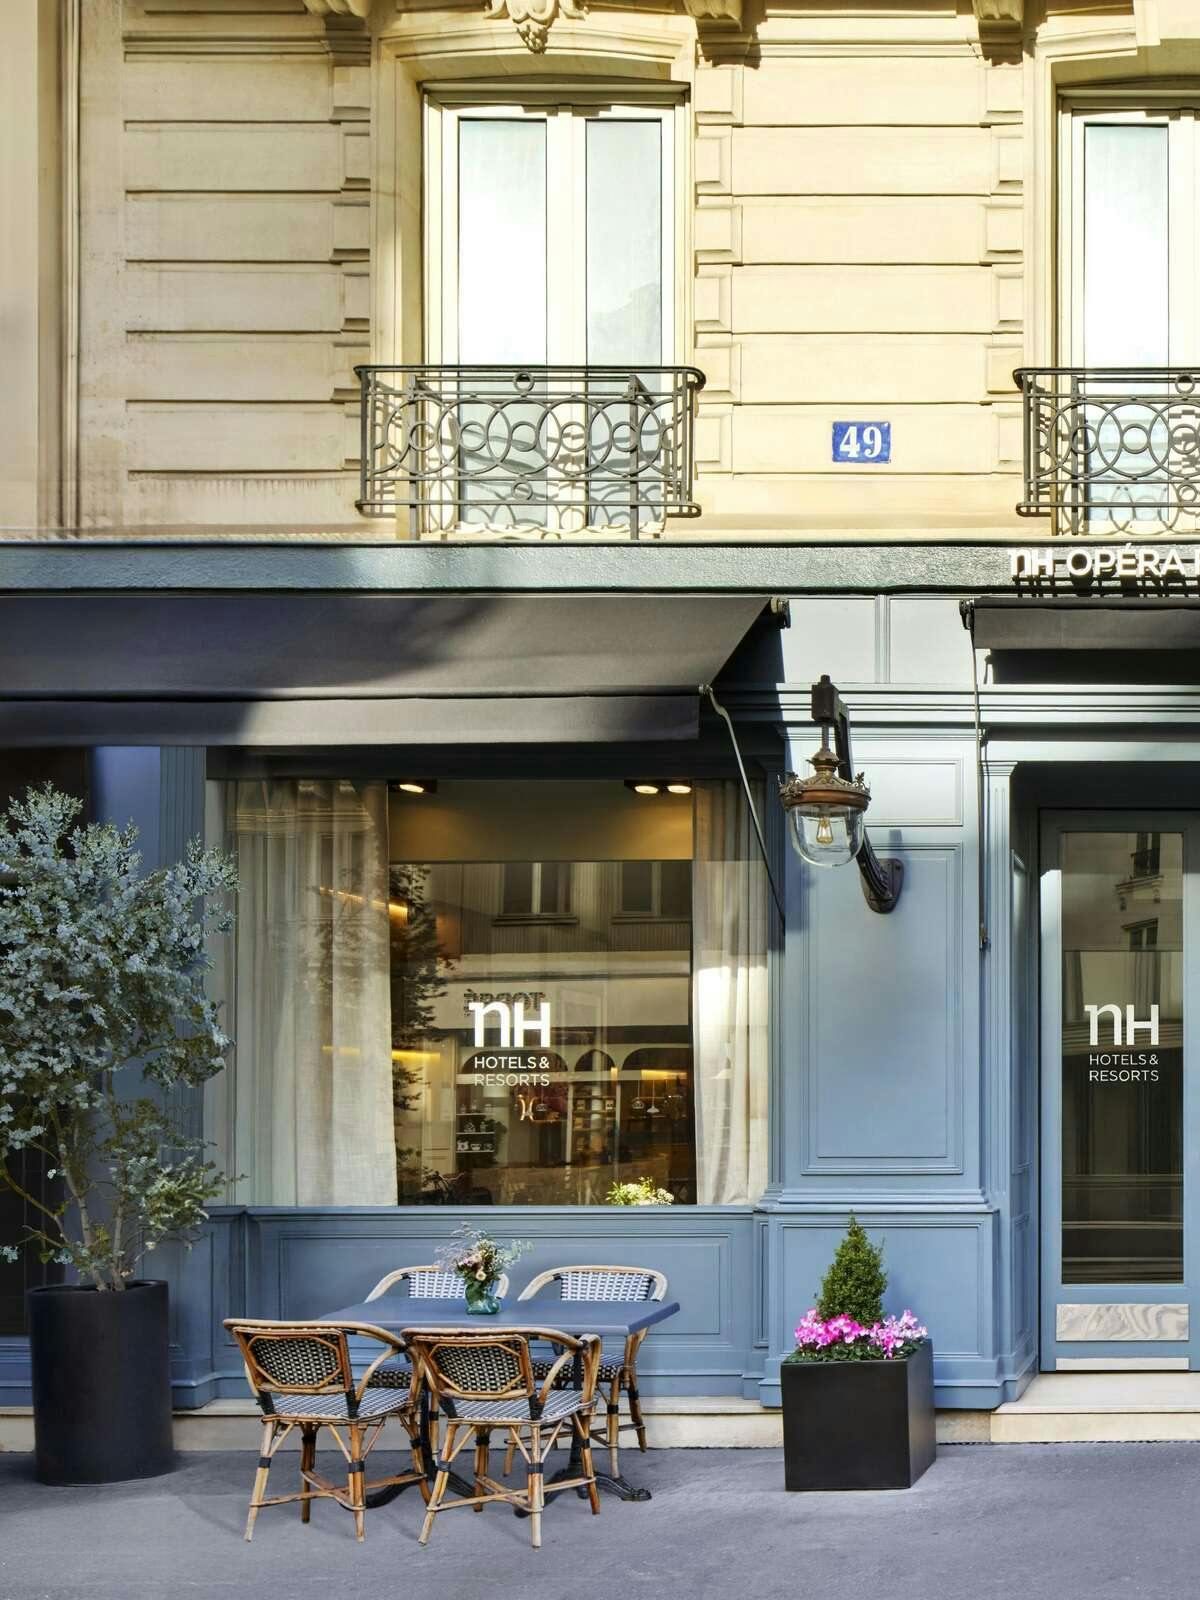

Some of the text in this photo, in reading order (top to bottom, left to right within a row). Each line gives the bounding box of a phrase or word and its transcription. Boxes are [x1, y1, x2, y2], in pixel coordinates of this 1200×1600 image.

[839, 426, 881, 458] 49
[1066, 542, 1186, 576] OPÉRA
[474, 1056, 537, 1069] HOTELS
[1089, 1054, 1146, 1066] HOTELS
[474, 1073, 550, 1086] RESORTS
[1089, 1070, 1159, 1082] RESORTS
